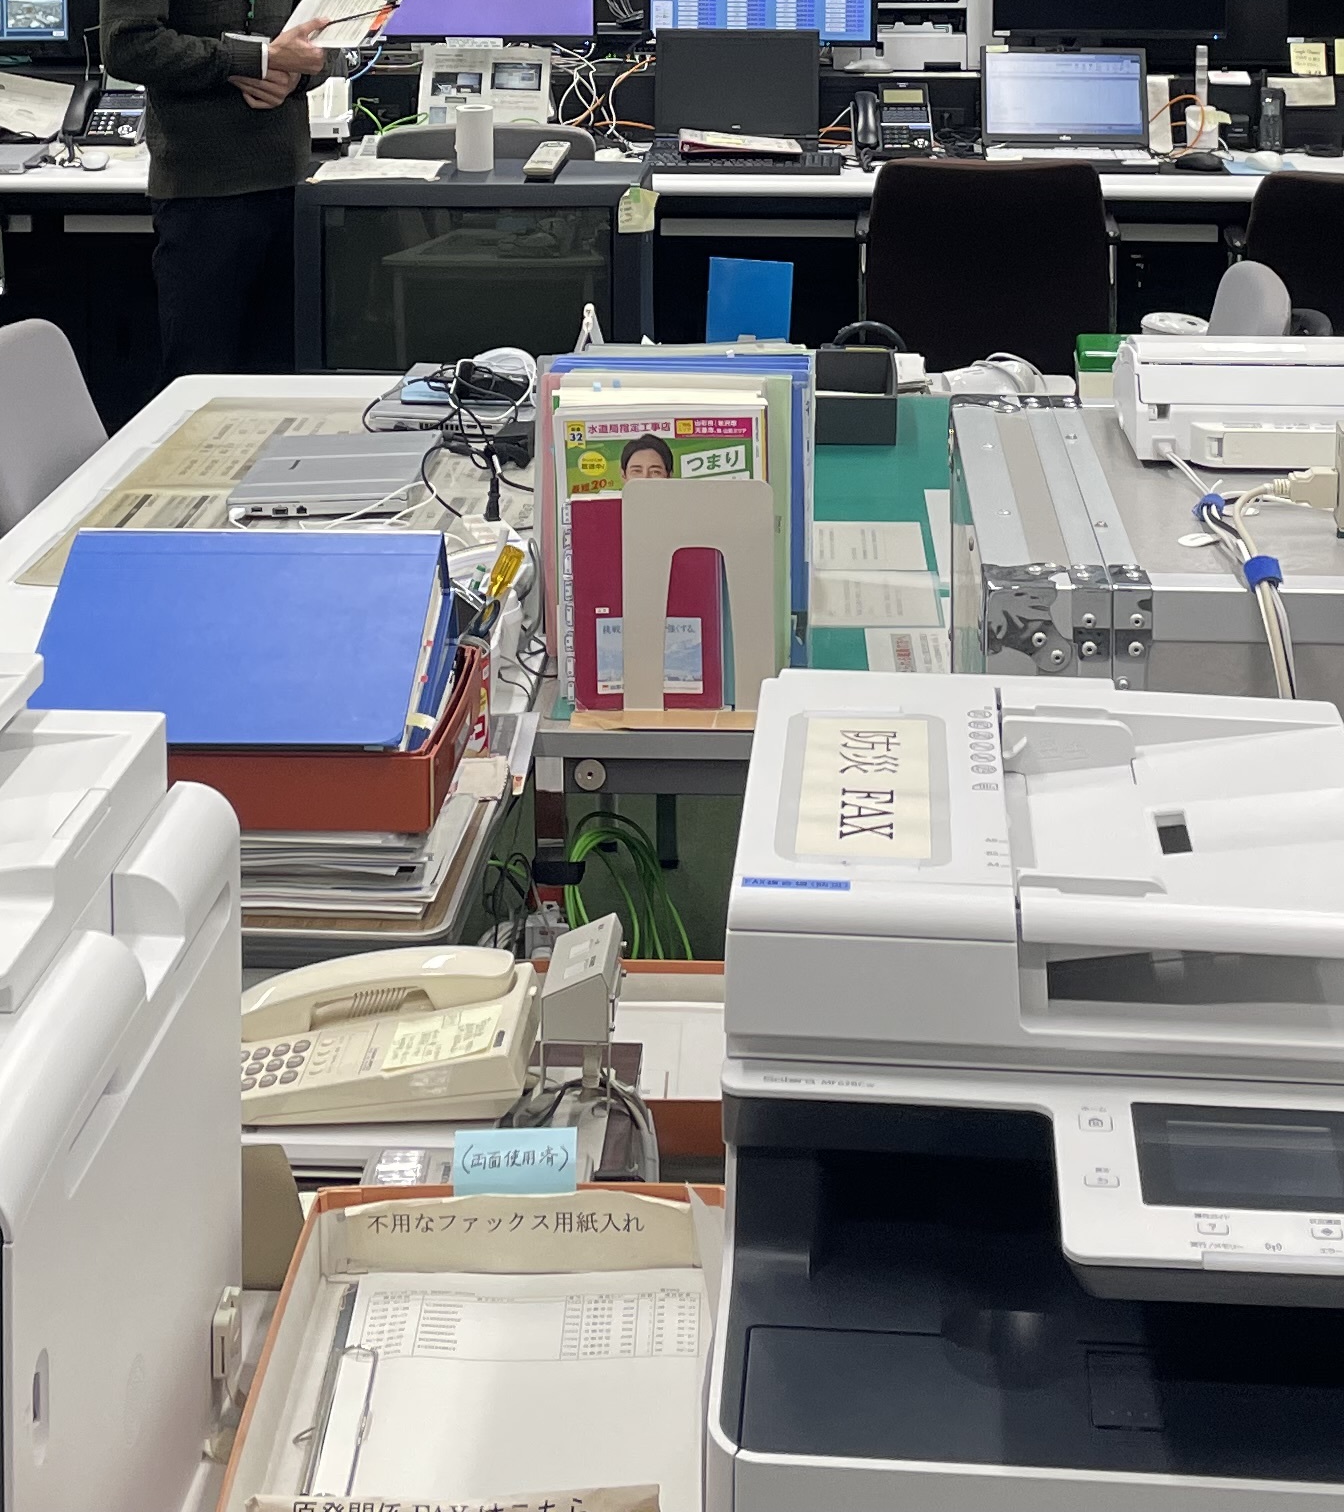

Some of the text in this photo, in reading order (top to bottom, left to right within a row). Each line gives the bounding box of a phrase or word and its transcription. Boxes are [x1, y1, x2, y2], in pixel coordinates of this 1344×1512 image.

[569, 433, 583, 441] 32
[686, 449, 740, 472] つまり
[839, 729, 901, 839] 防災 FAX
[367, 1211, 645, 1234] 不用なファックス用紙入れ
